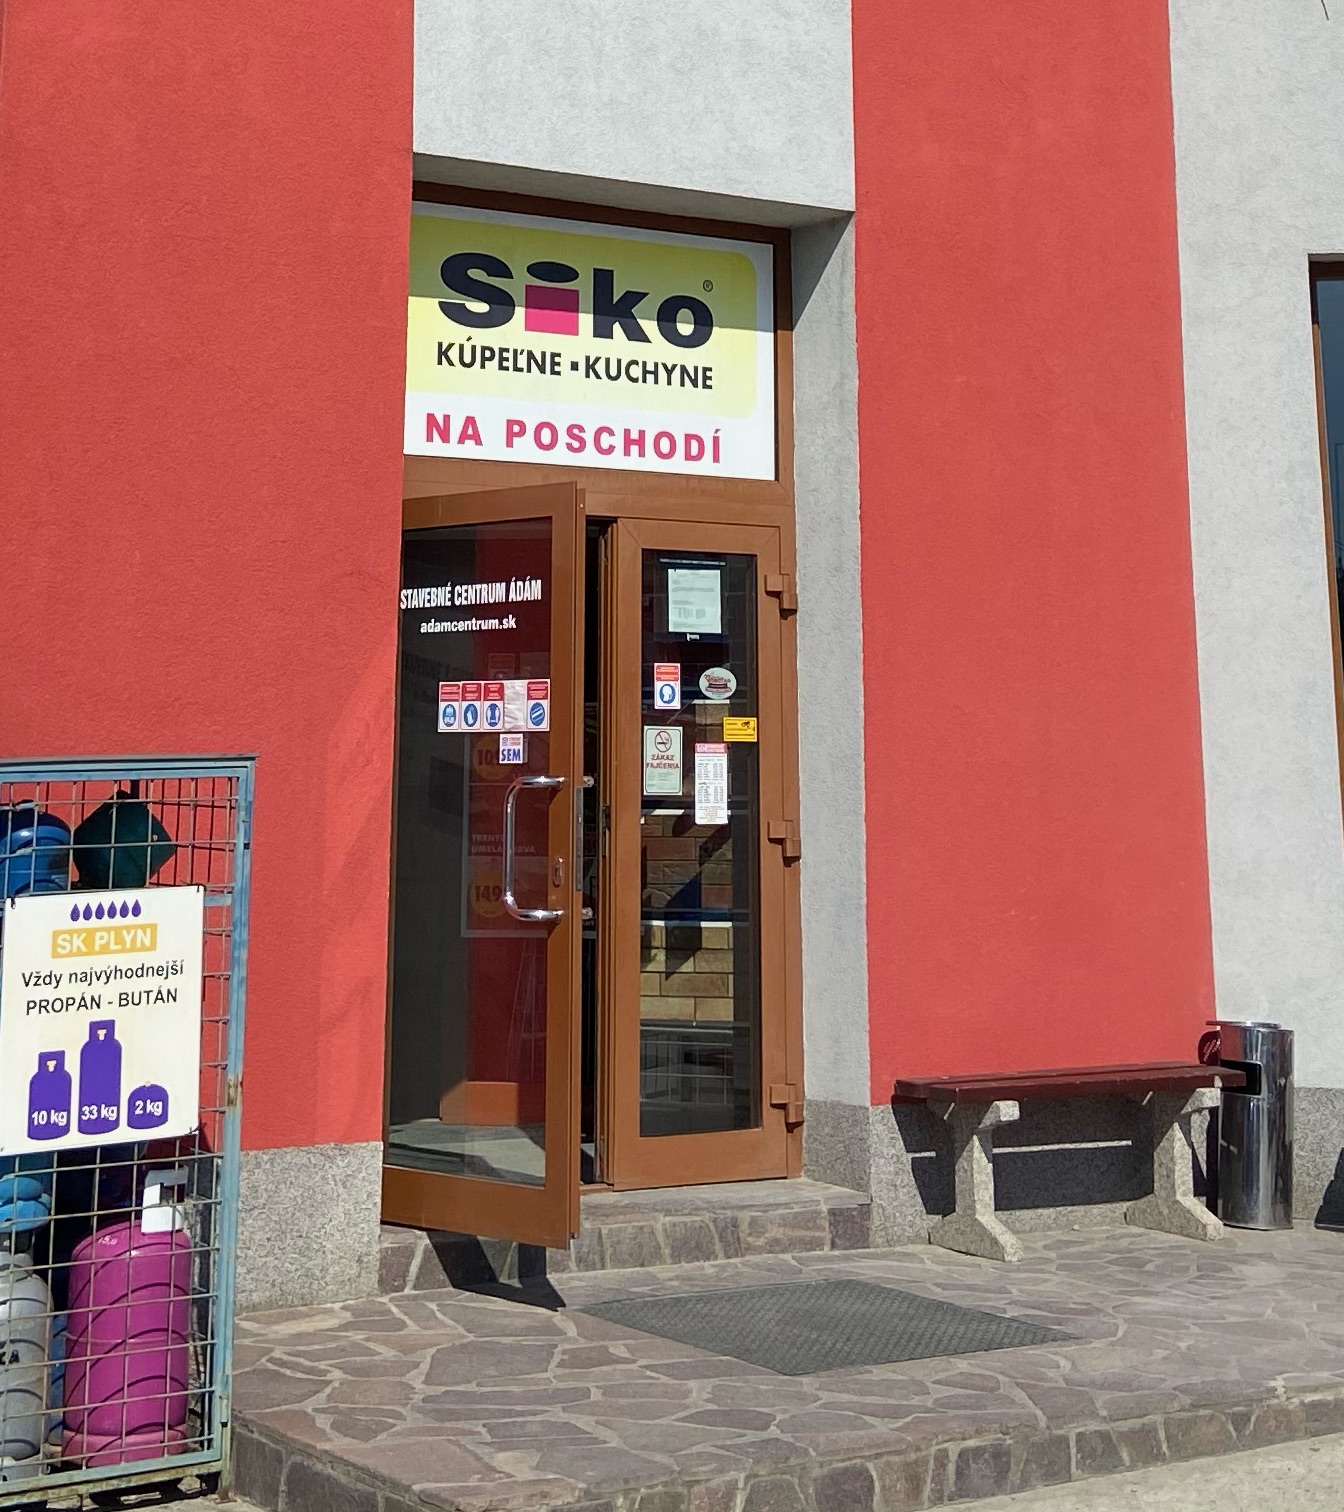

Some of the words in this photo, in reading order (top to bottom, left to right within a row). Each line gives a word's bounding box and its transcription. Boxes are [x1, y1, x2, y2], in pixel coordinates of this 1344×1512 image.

[436, 336, 562, 377] KÚPEĽNE
[584, 354, 714, 390] KUCHYNE
[425, 412, 484, 447] NA
[506, 418, 722, 464] POSCHODÍ
[400, 581, 452, 609] STAVEBNÉ
[454, 582, 506, 607] CENTRUM
[508, 576, 542, 602] ÁDÁM
[420, 614, 517, 633] adamcentrum.sk
[501, 748, 522, 762] SEM
[56, 932, 88, 955] SK
[94, 927, 152, 951] PLYN
[21, 966, 63, 989] Vždy
[68, 959, 184, 985] najvýhodnejší
[25, 992, 102, 1016] PROPÁN
[118, 984, 178, 1009] BUTÁN
[31, 1110, 47, 1126] 10
[50, 1108, 67, 1127] kg
[81, 1105, 98, 1120] 33
[100, 1103, 118, 1121] kg
[134, 1100, 143, 1115] 2
[144, 1098, 163, 1116] kg
